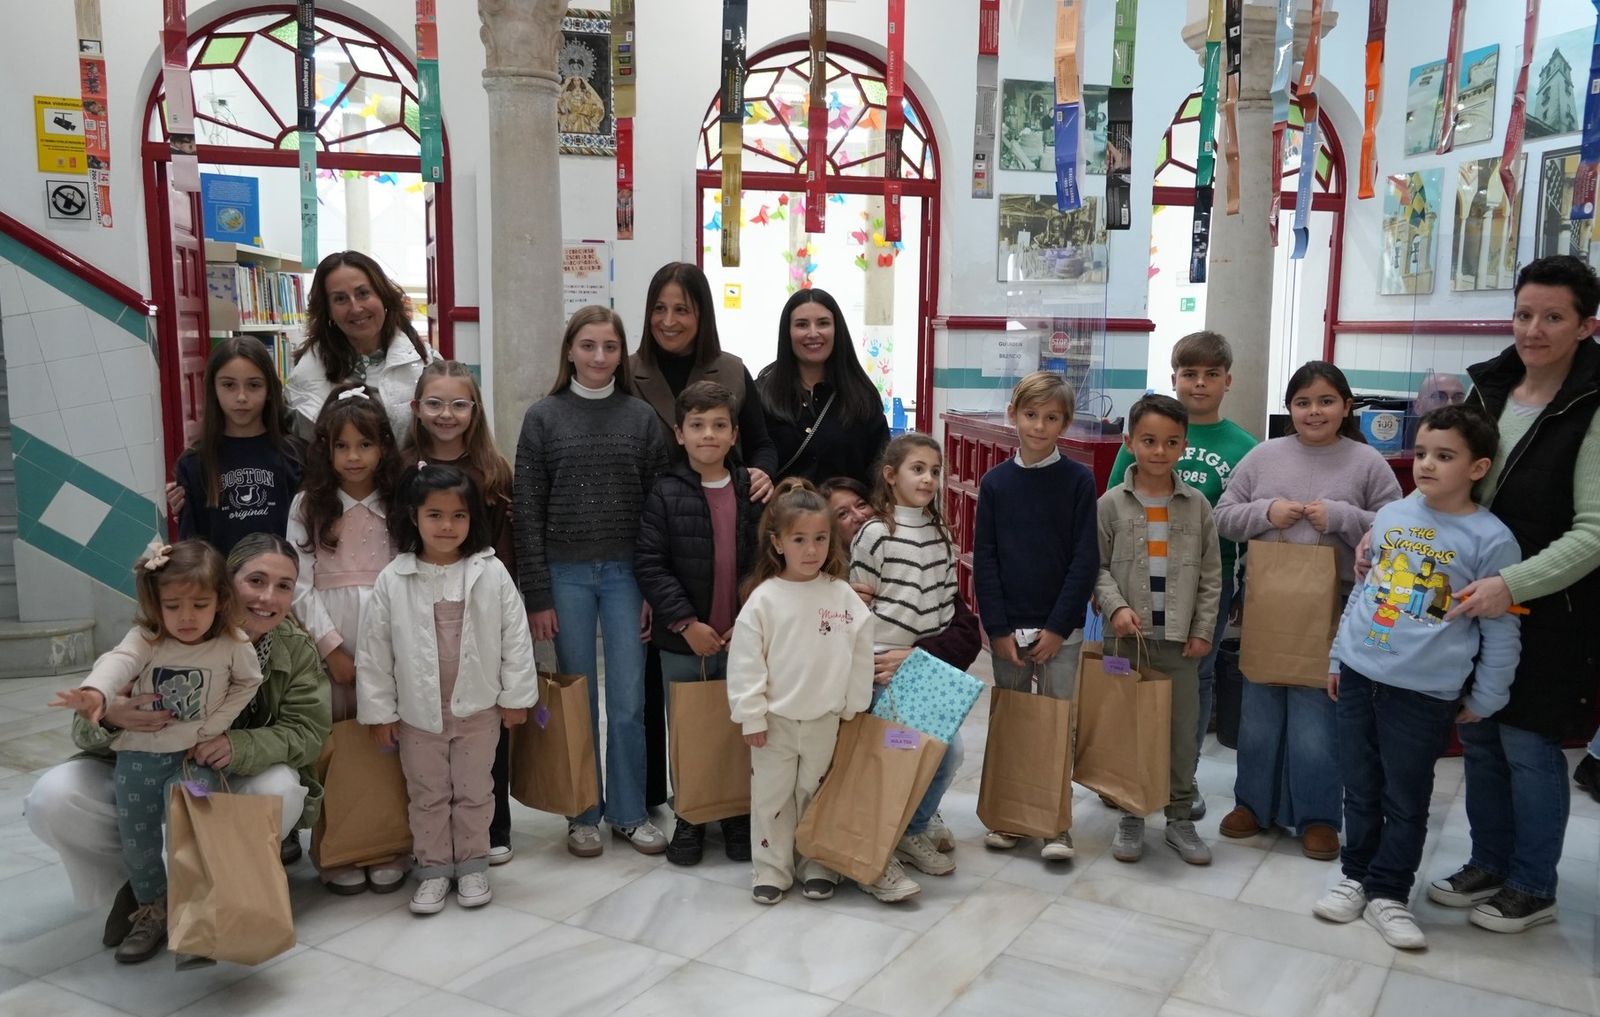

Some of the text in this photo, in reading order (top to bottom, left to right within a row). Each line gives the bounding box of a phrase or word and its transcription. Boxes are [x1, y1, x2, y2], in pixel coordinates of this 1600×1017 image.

[302, 70, 310, 107] asquerosos
[1051, 336, 1068, 346] STOP
[1177, 469, 1208, 484] 1985
[229, 507, 268, 519] original
